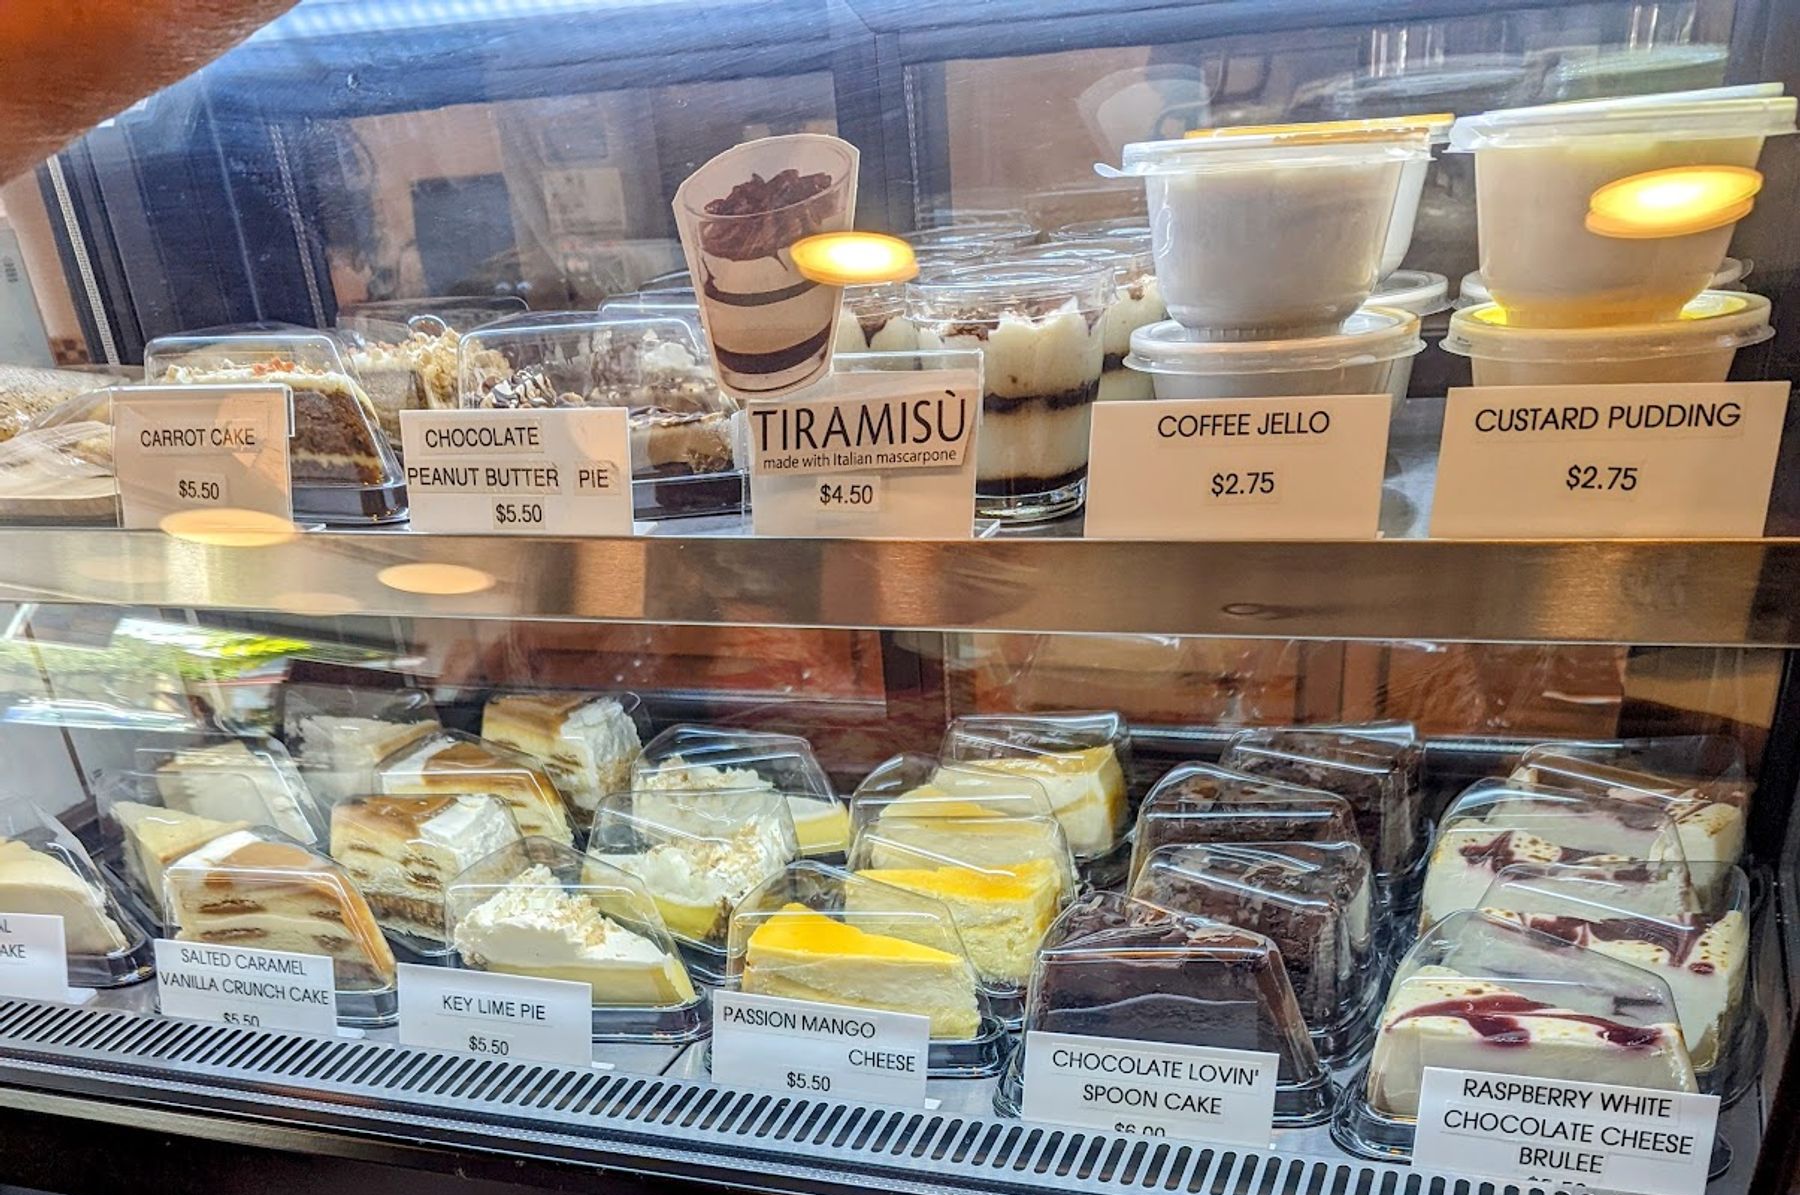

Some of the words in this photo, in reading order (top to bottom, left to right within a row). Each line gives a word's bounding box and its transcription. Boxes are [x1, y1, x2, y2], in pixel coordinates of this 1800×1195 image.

[752, 389, 966, 452] TIRAMISÙ
[1157, 412, 1251, 439] COFFEE
[1257, 410, 1330, 437] JELLO
[1474, 405, 1600, 434] CUSTARD
[1607, 401, 1741, 430] PUDDING
[140, 428, 206, 449] CARROT
[210, 427, 256, 447] CAKE
[424, 427, 540, 449] CHOCOLATE
[763, 455, 799, 470] made
[802, 453, 830, 468] with
[833, 451, 873, 467] Italian
[876, 448, 957, 466] mascarpone
[178, 479, 220, 501] $5.50
[408, 467, 480, 488] PEANUT
[486, 468, 560, 489] BUTTER
[578, 468, 610, 489] PIE
[1210, 471, 1276, 497] $2.75
[1565, 464, 1638, 492] $2.75
[819, 483, 874, 506] $4.50
[495, 503, 543, 524] $5.50
[181, 948, 231, 968] SALTED
[235, 954, 307, 976] CARAMEL
[160, 970, 217, 993] VANILLA
[222, 978, 285, 1000] CRUNCH
[289, 986, 329, 1005] CAKE
[223, 1011, 260, 1028] $550
[441, 994, 473, 1013] KEY
[478, 998, 516, 1017] LIME
[520, 1001, 546, 1021] PIE
[722, 1005, 797, 1031] PASSION
[801, 1015, 876, 1039] MANGO
[468, 1034, 510, 1056] $5.50
[848, 1048, 916, 1073] CHEESE
[1052, 1049, 1183, 1080] CHOCOLATE
[1188, 1063, 1259, 1086] LOVIN'
[786, 1070, 832, 1093] $5.50
[1082, 1084, 1158, 1108] SPOON
[1164, 1092, 1223, 1115] CAKE
[1463, 1078, 1593, 1109] RASPBERRY
[1600, 1092, 1673, 1118] WHITE
[1113, 1121, 1166, 1138] $600
[1443, 1109, 1595, 1143] CHOCOLATE
[1600, 1126, 1694, 1156] CHEESE
[1518, 1147, 1605, 1174] BRULEE
